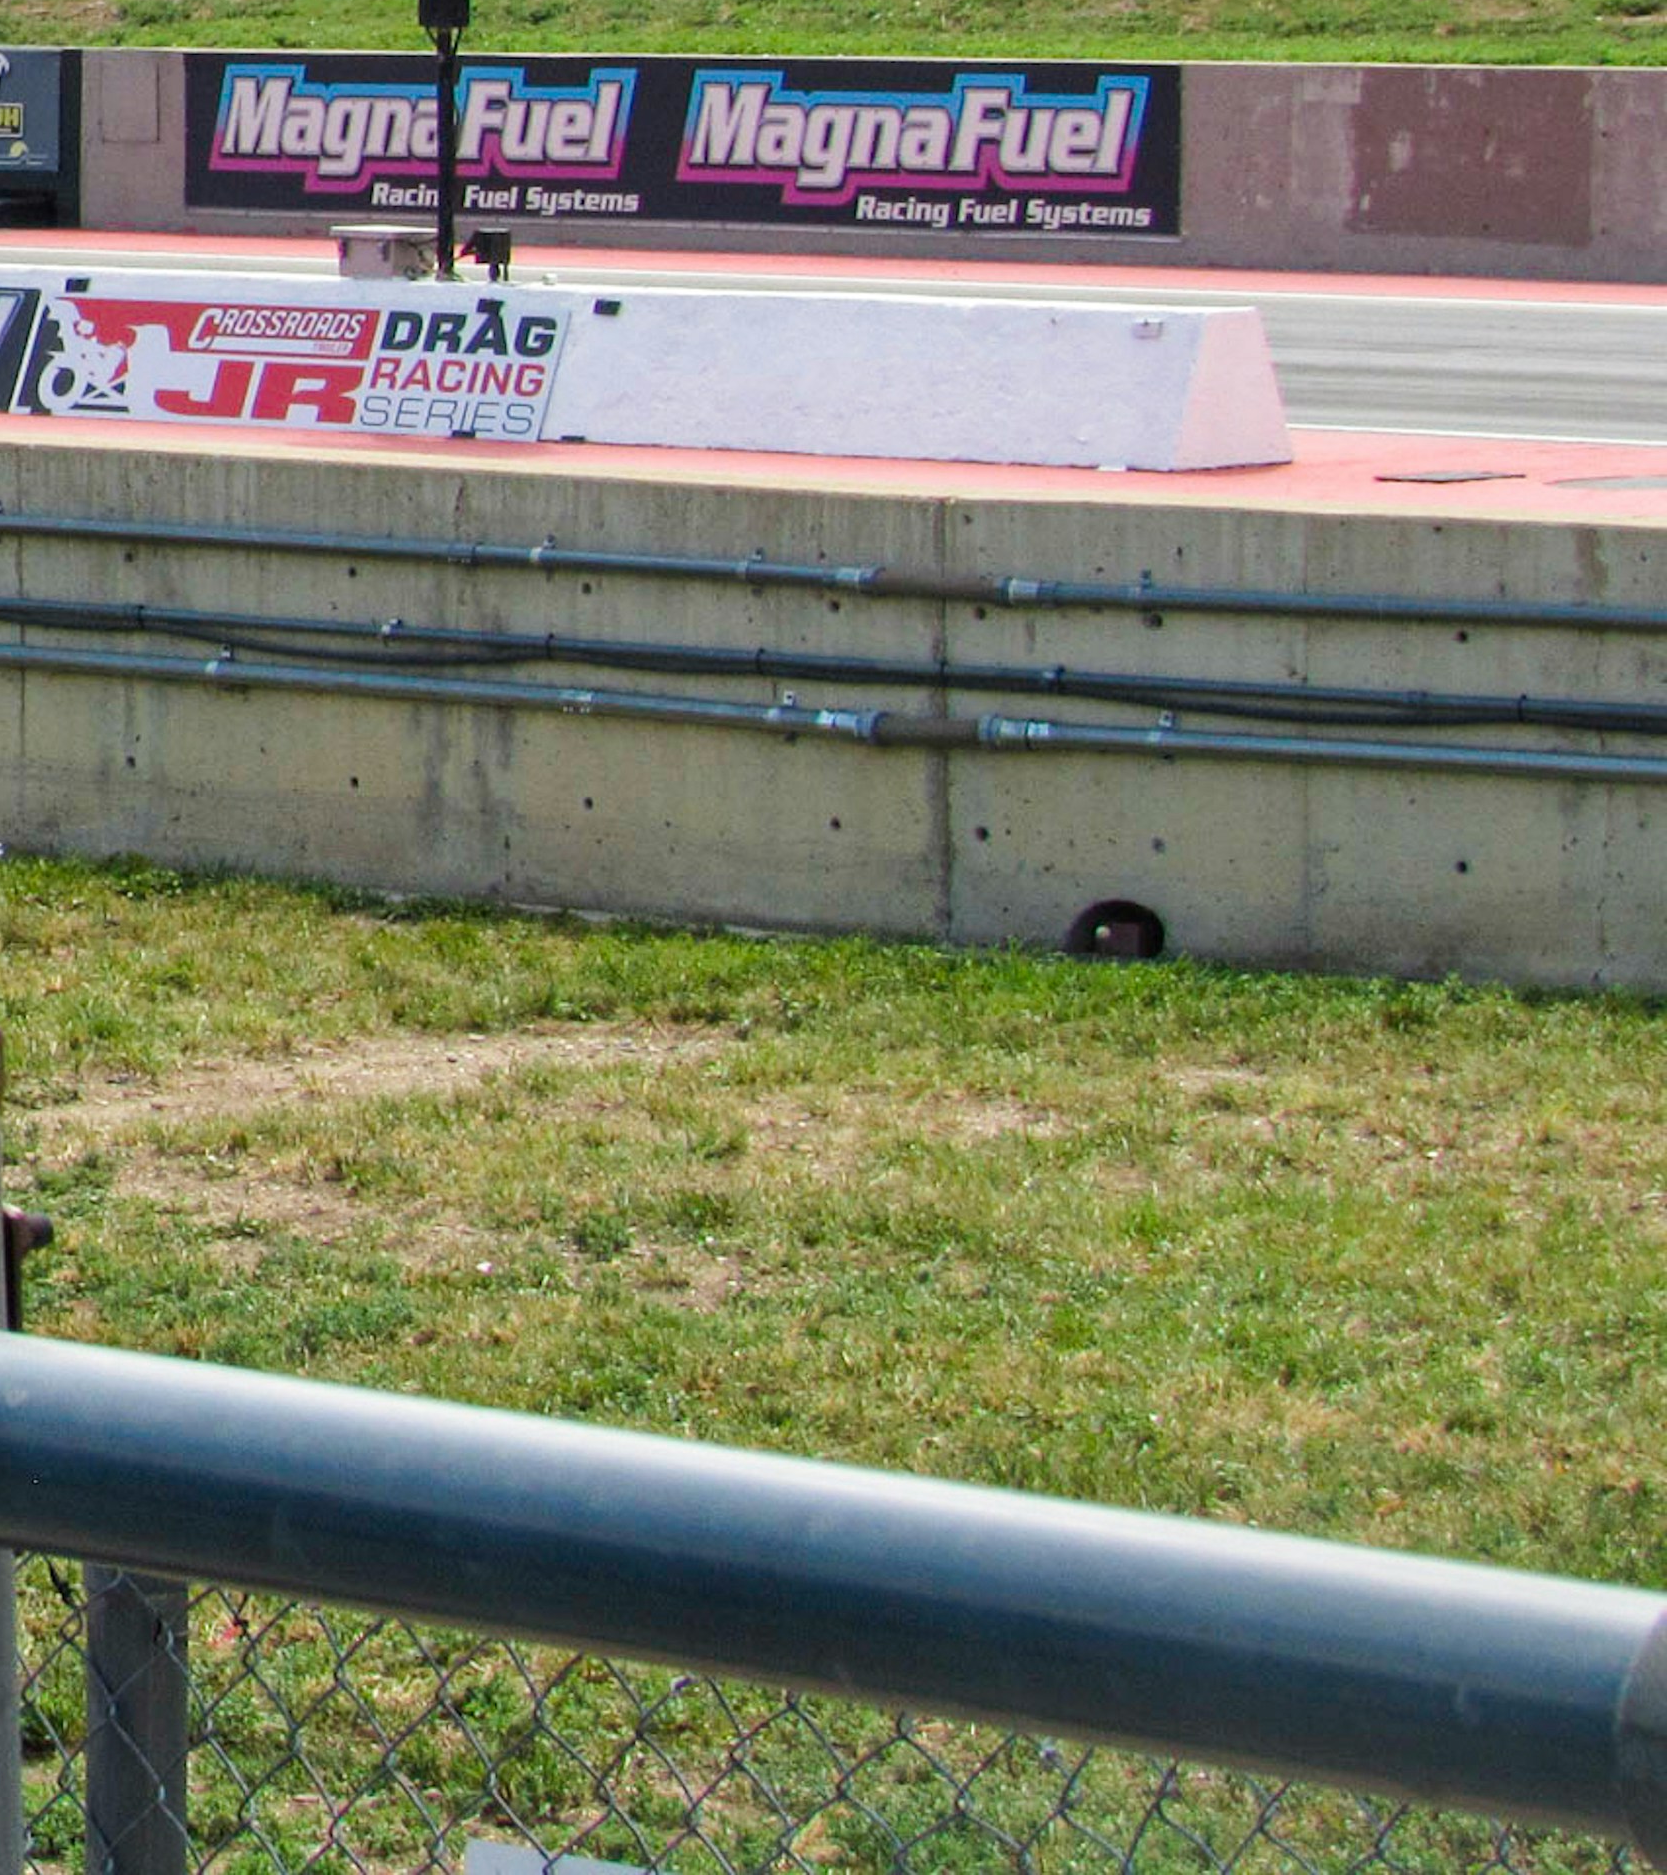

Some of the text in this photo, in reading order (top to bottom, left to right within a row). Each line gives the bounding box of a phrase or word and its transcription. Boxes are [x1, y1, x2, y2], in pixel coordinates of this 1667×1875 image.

[689, 82, 1133, 188] MagnaFuel
[371, 182, 640, 217] Racin Fuel Systems
[856, 195, 1152, 230] Racing Fuel Systems
[188, 308, 365, 349] CROSSROADS
[380, 309, 559, 359] DRAG
[153, 359, 364, 425] JR
[368, 356, 548, 398] RACING
[359, 395, 537, 437] SERIES
